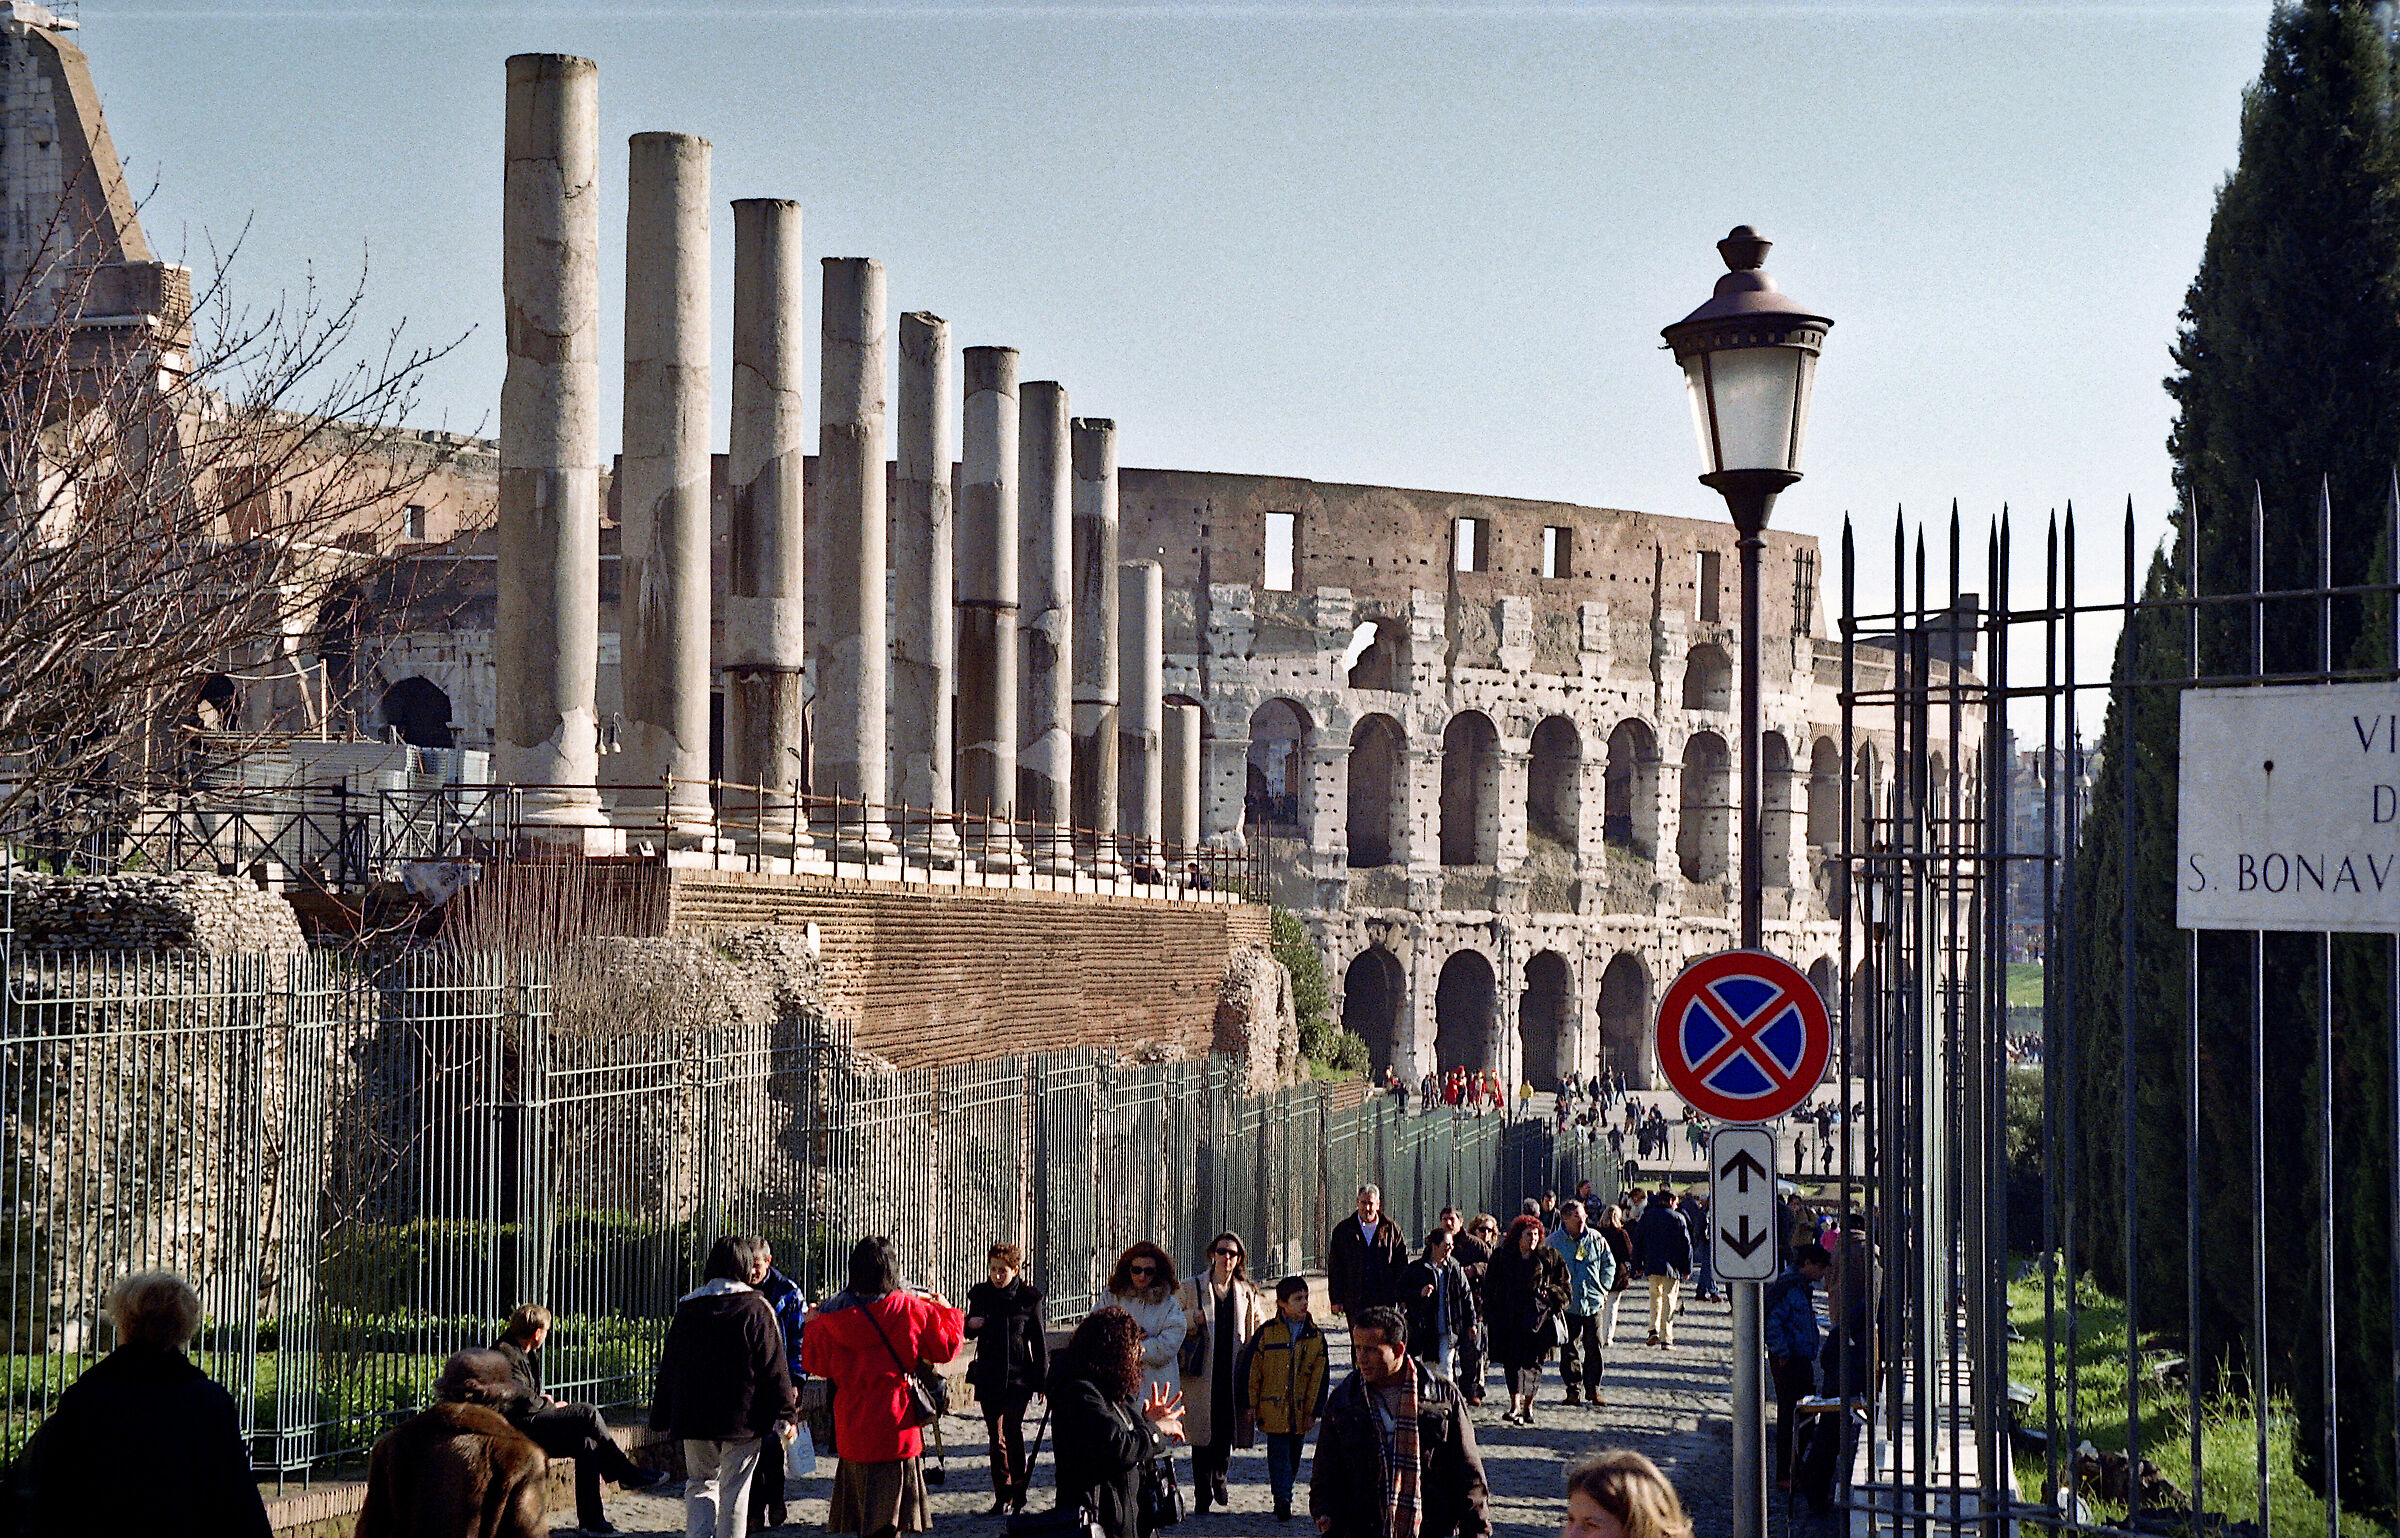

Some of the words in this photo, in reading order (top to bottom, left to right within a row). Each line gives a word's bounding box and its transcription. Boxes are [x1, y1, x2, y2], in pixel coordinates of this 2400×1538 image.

[2353, 714, 2396, 753] VI
[2187, 853, 2218, 893] S.
[2238, 853, 2394, 893] BONAV
